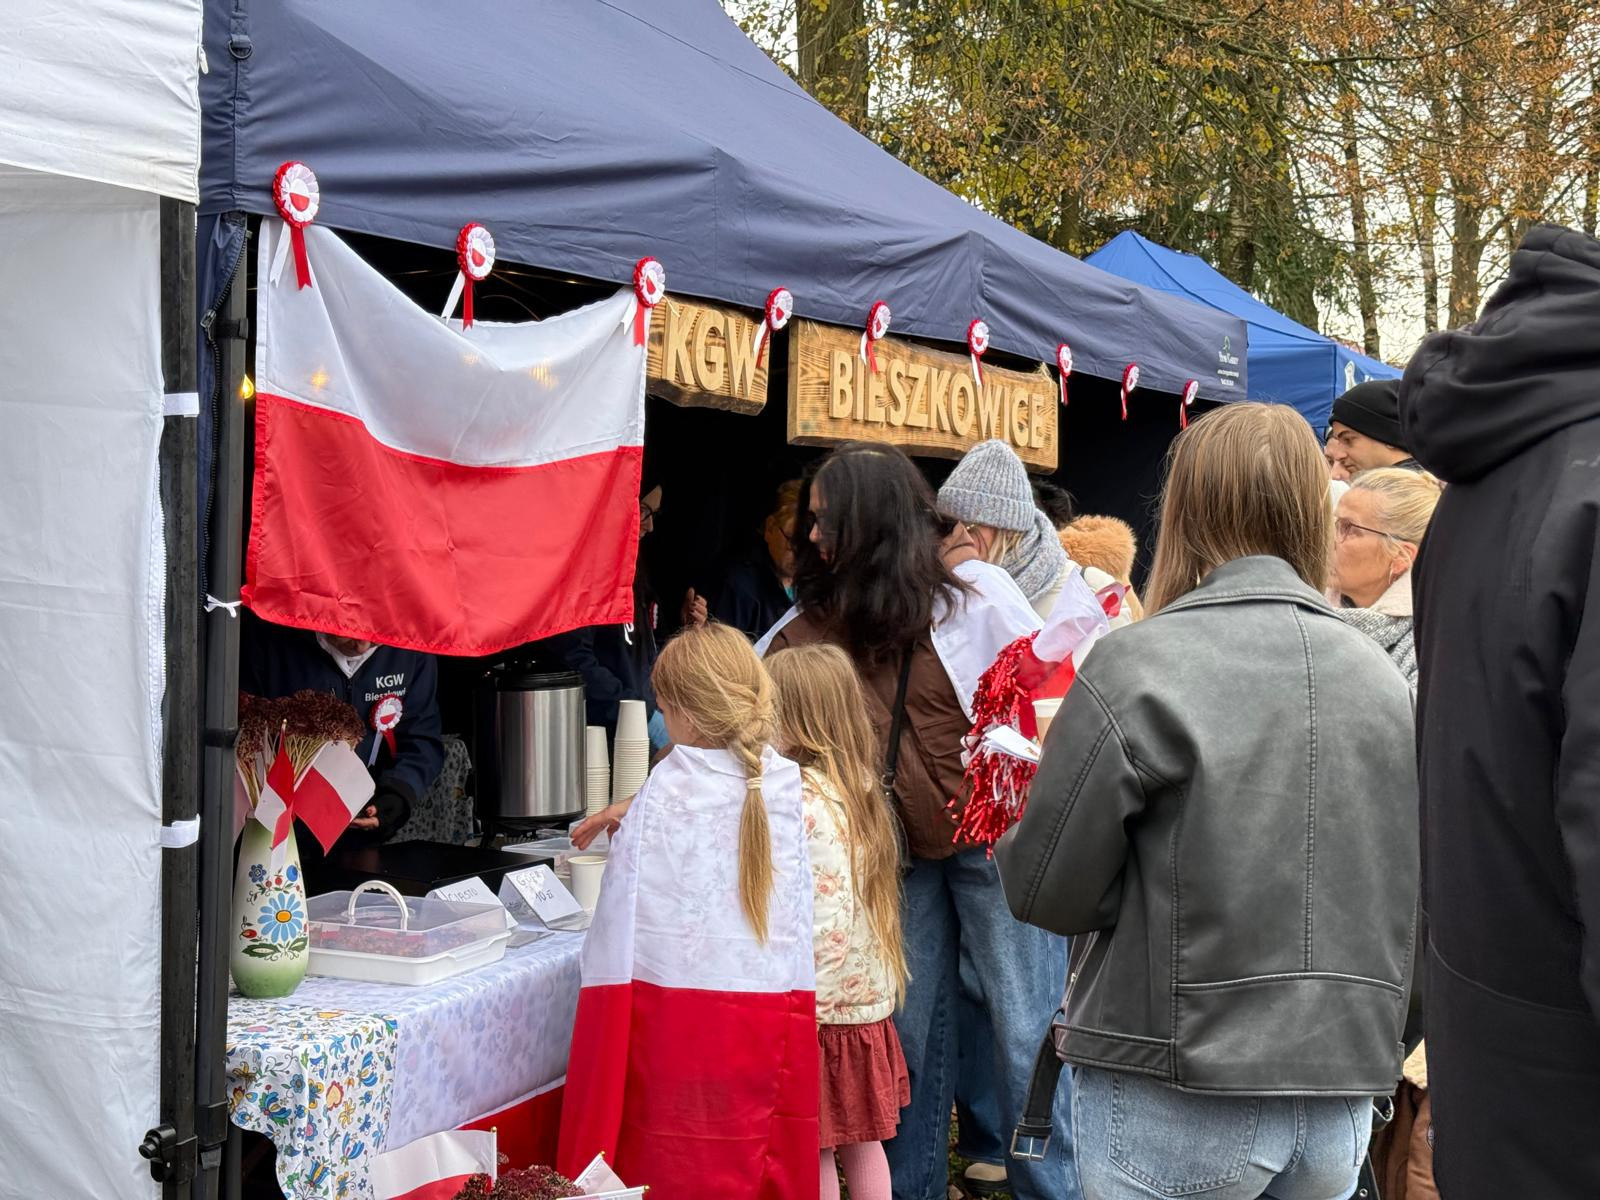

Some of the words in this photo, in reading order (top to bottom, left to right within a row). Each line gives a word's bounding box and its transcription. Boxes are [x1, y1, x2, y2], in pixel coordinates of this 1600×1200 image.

[662, 300, 760, 398] KGW
[829, 349, 1044, 449] BIESZKOWICE
[375, 673, 405, 689] KGW
